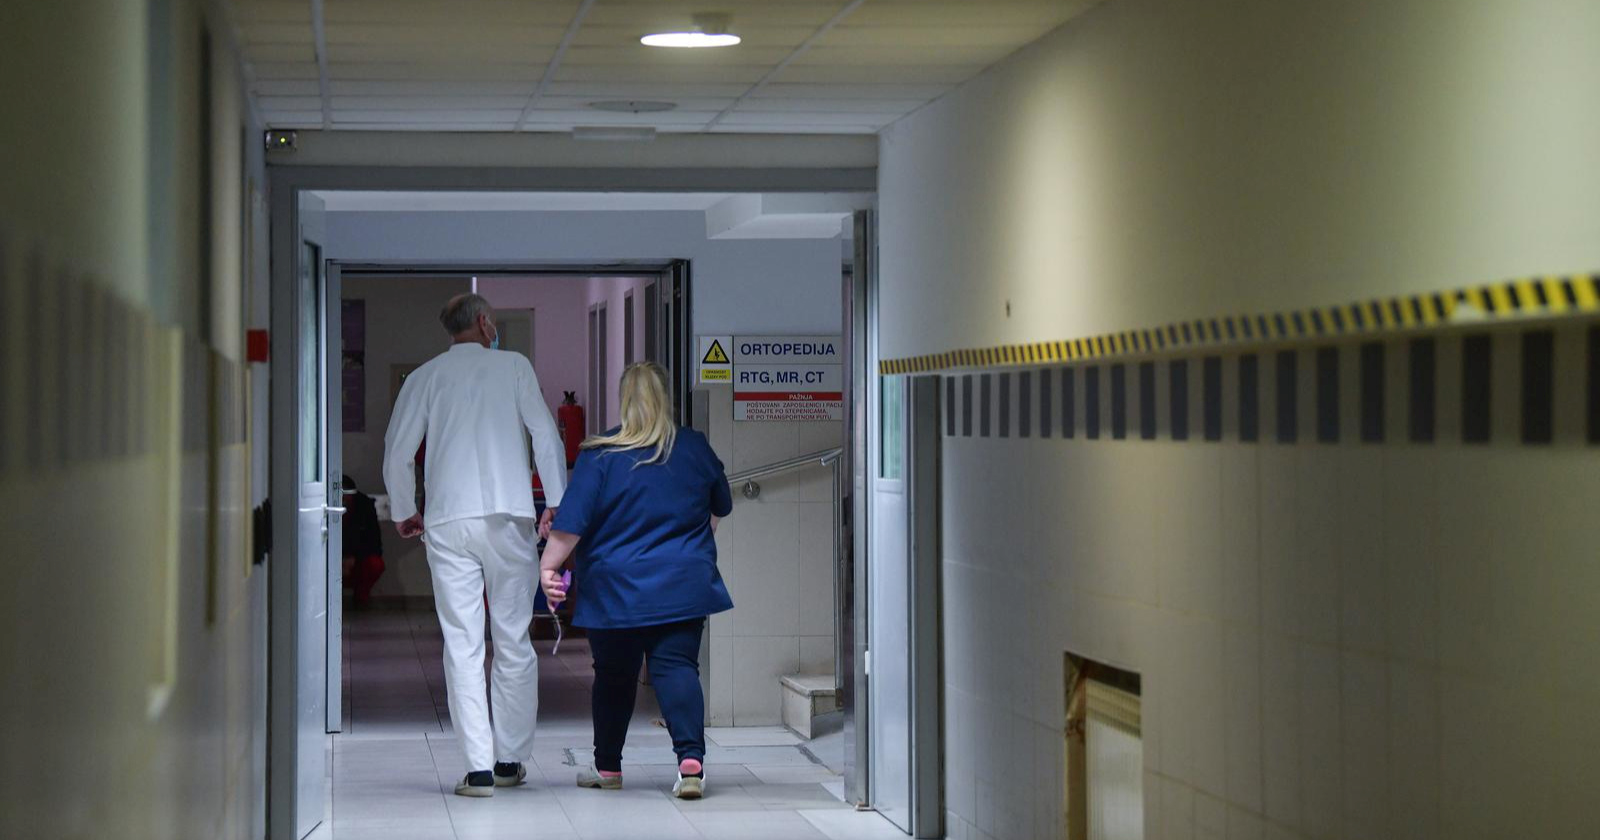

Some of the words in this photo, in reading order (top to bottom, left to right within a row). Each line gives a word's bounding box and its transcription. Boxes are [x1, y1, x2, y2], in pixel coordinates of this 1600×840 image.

[741, 343, 835, 356] ORTOPEDIJA
[740, 371, 774, 385] RTG,
[776, 371, 803, 385] MR,
[805, 371, 824, 384] CT
